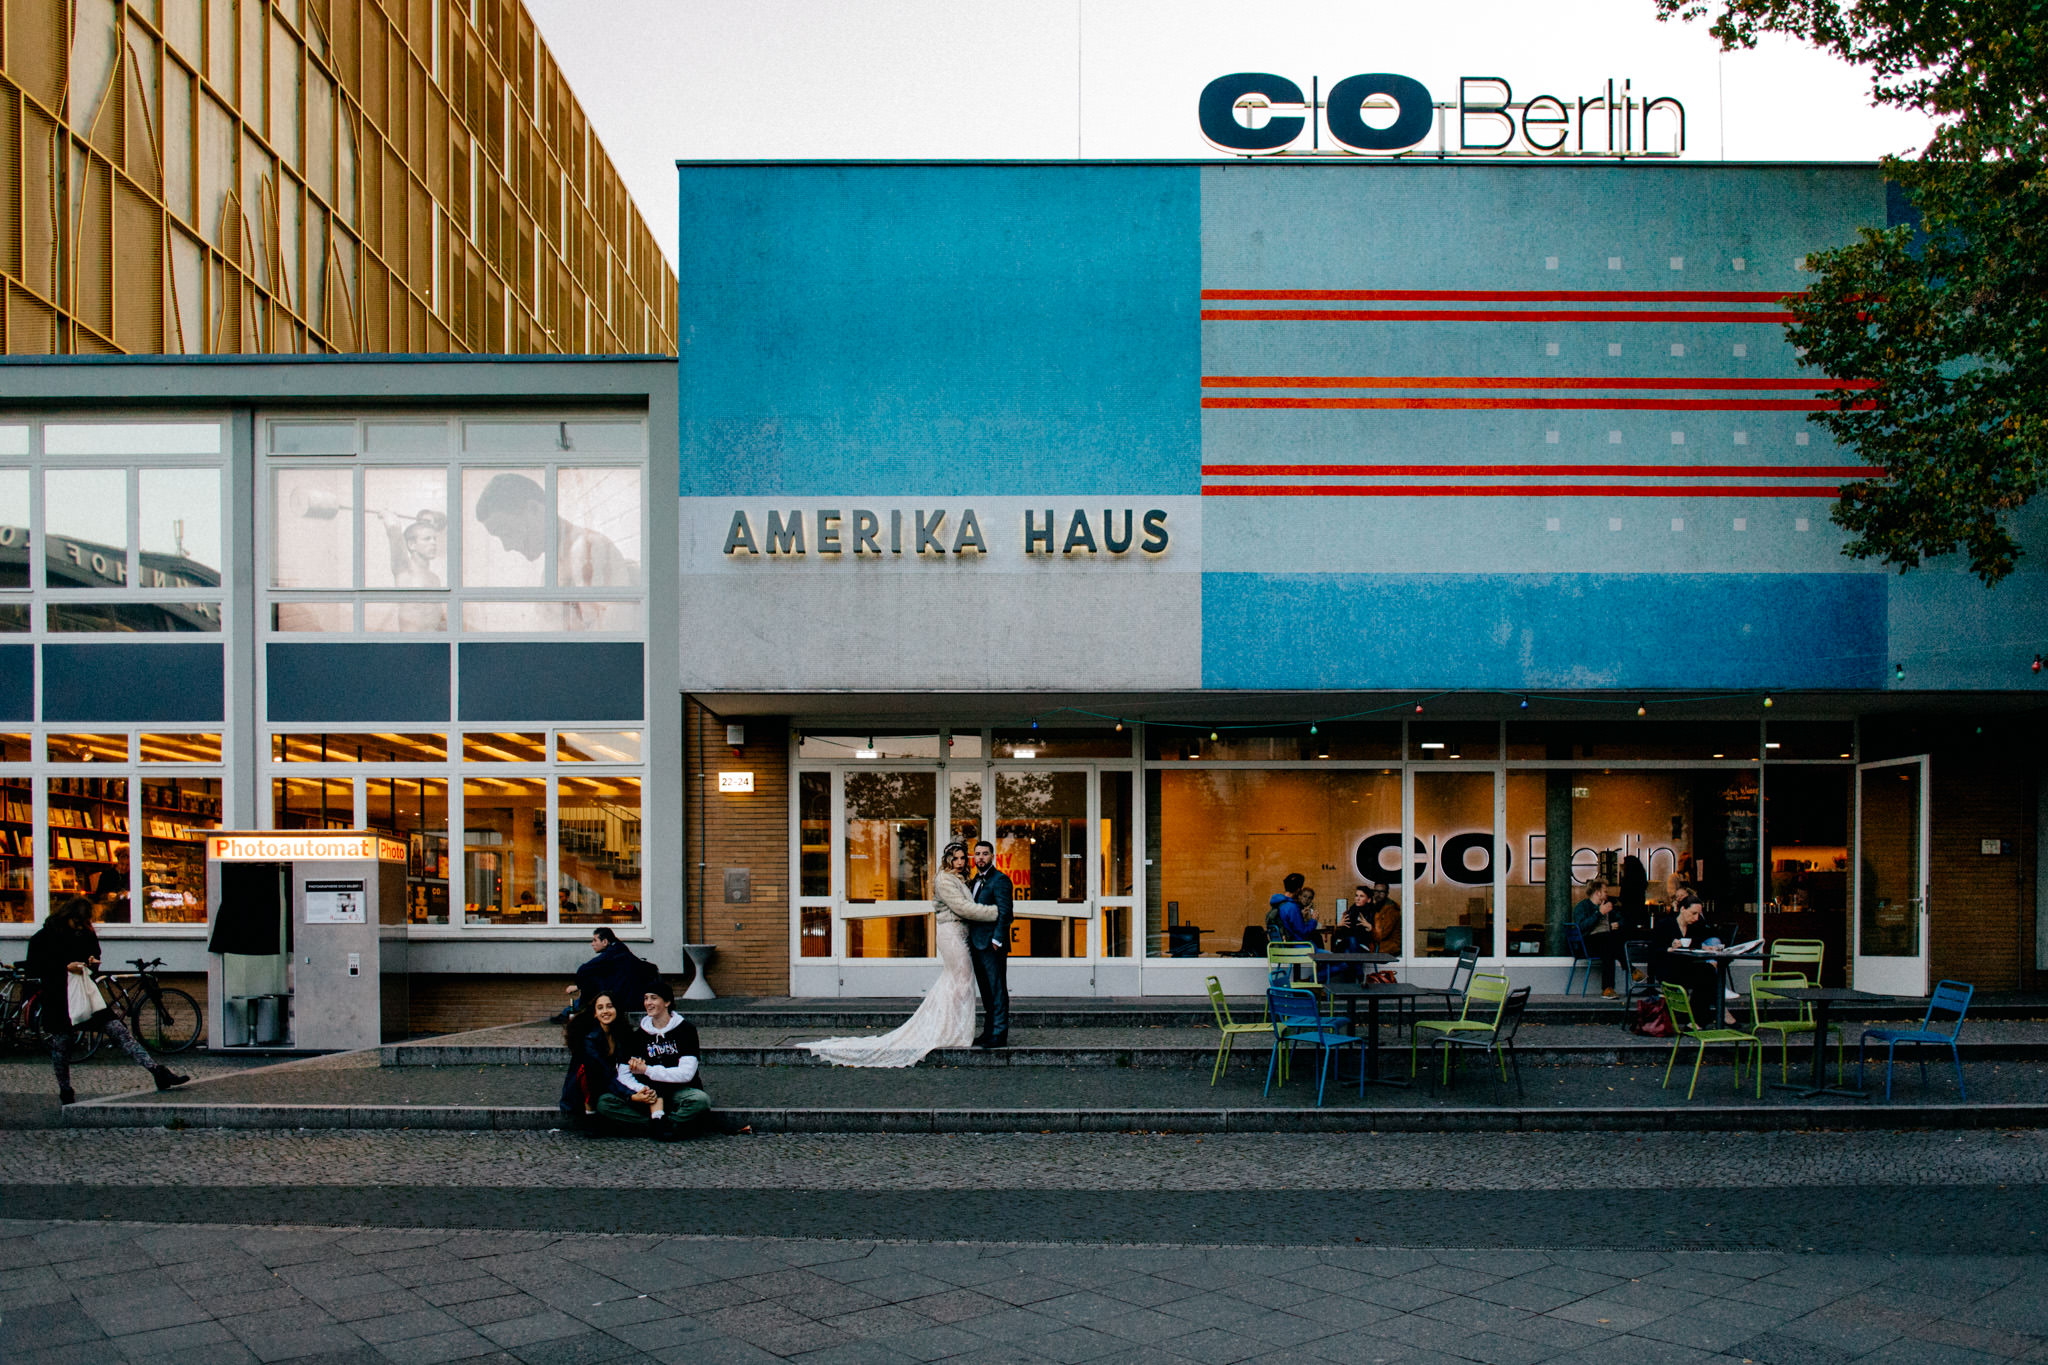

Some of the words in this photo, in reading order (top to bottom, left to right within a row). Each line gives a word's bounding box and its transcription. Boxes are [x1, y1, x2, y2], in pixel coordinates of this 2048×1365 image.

[1458, 76, 1686, 153] Berlin
[724, 508, 987, 555] AMERIKA
[1025, 508, 1170, 555] HAUS
[721, 777, 749, 787] 22-24
[216, 839, 369, 857] Photoautomat
[380, 841, 405, 860] Photo
